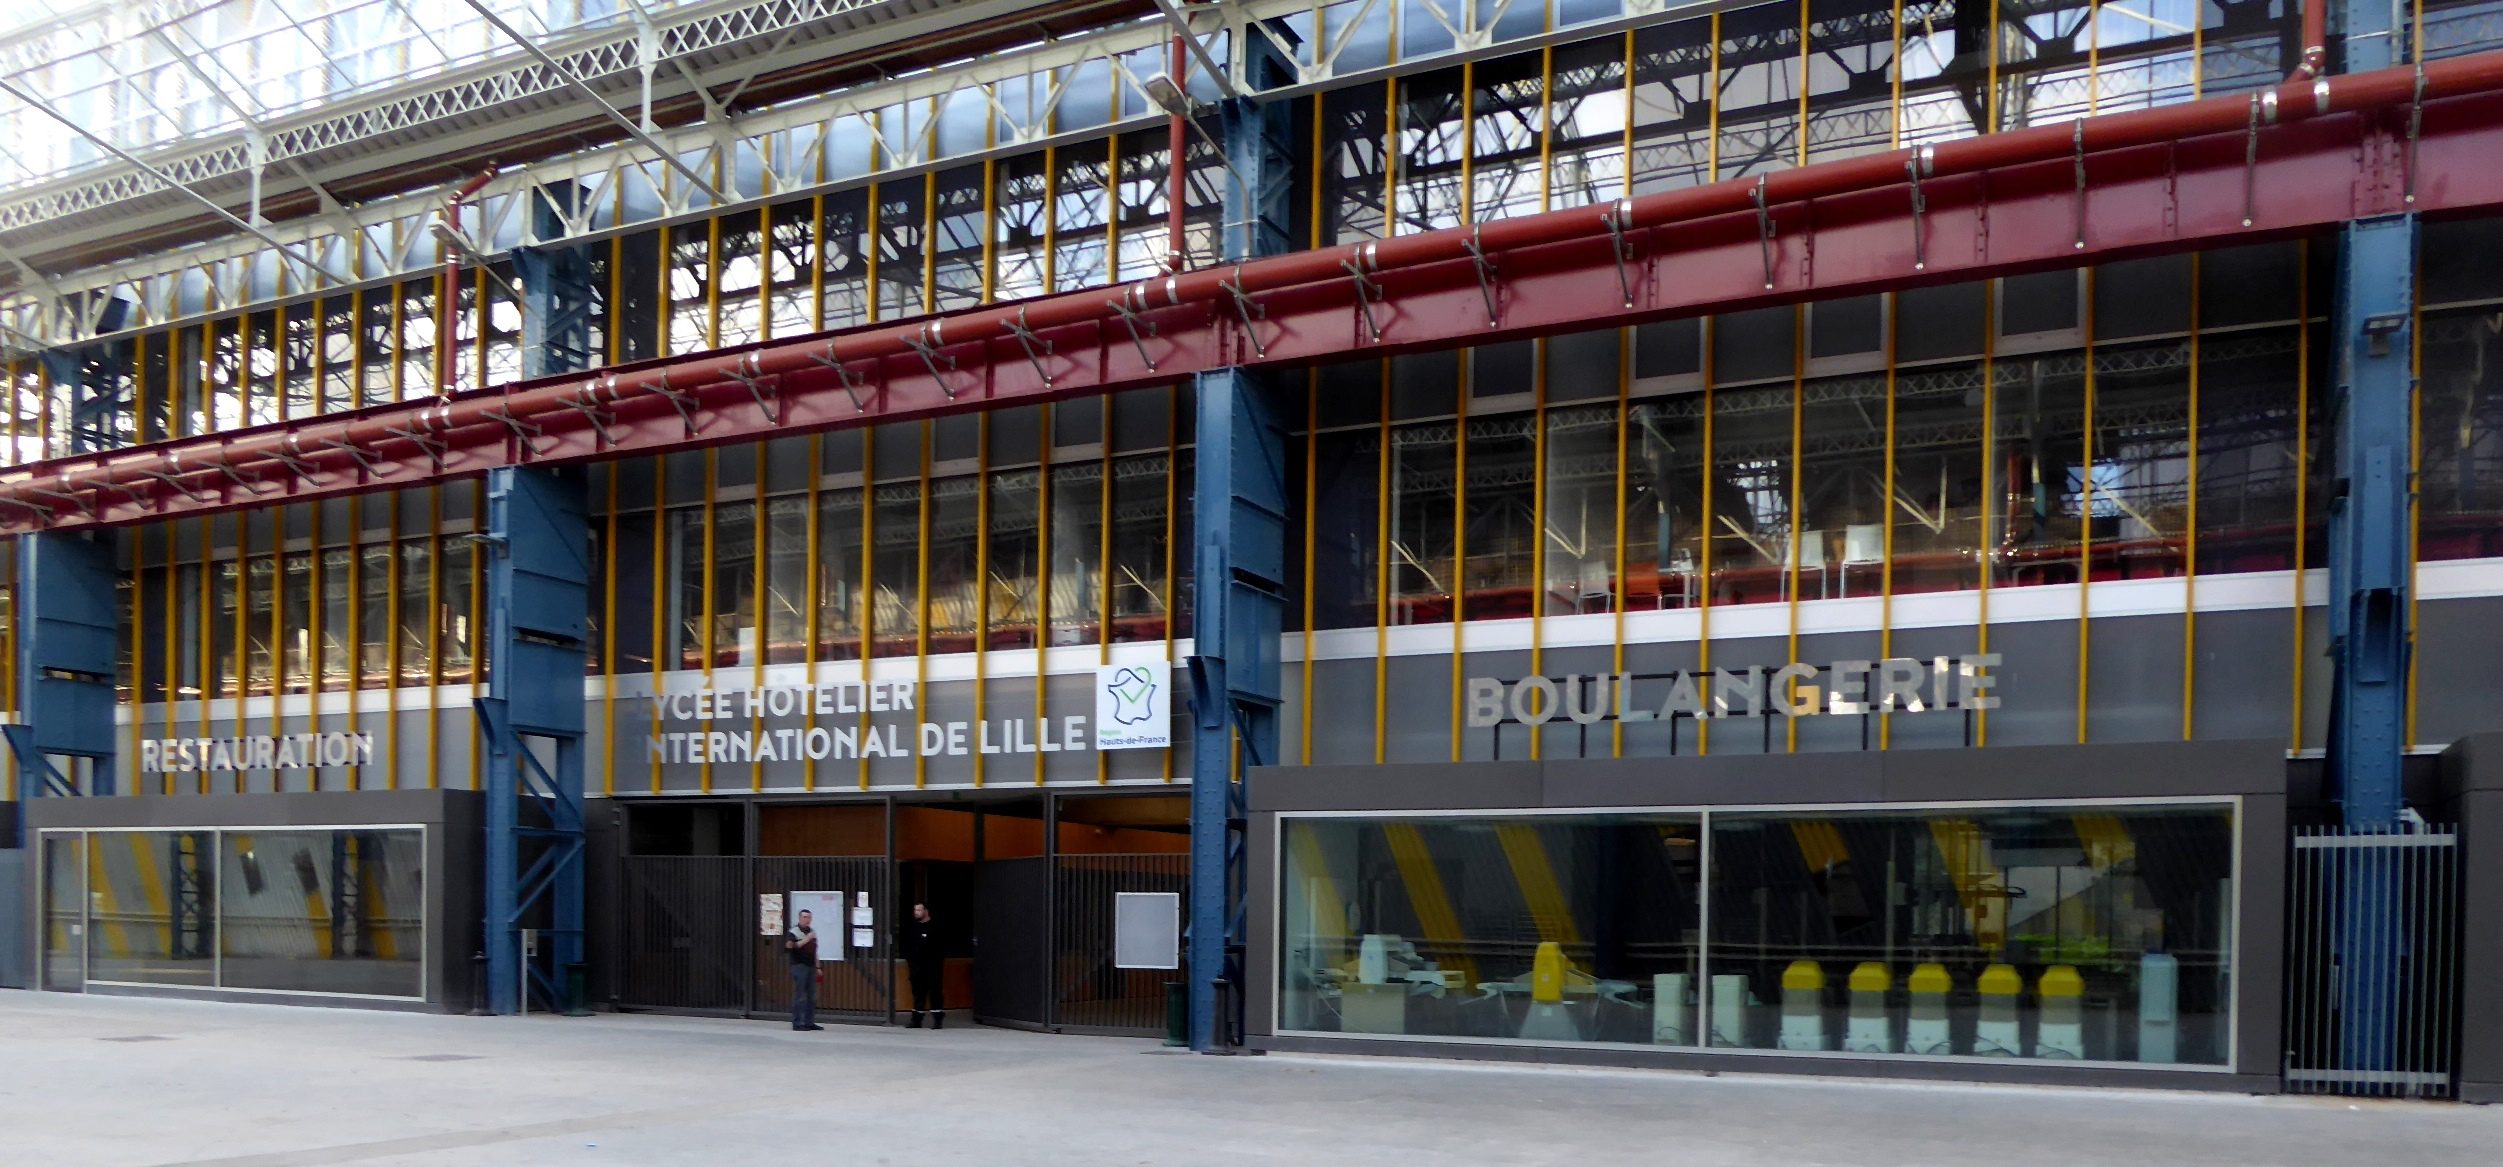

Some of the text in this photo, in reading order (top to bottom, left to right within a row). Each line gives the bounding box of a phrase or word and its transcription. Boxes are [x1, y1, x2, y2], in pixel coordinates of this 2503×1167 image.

[1467, 653, 2001, 727] BOULANGERIE
[142, 731, 373, 772] RESTAURATION
[638, 716, 1086, 763] NTERNATIONAL DE LILLE
[1100, 736, 1166, 745] Hauts-de-France
